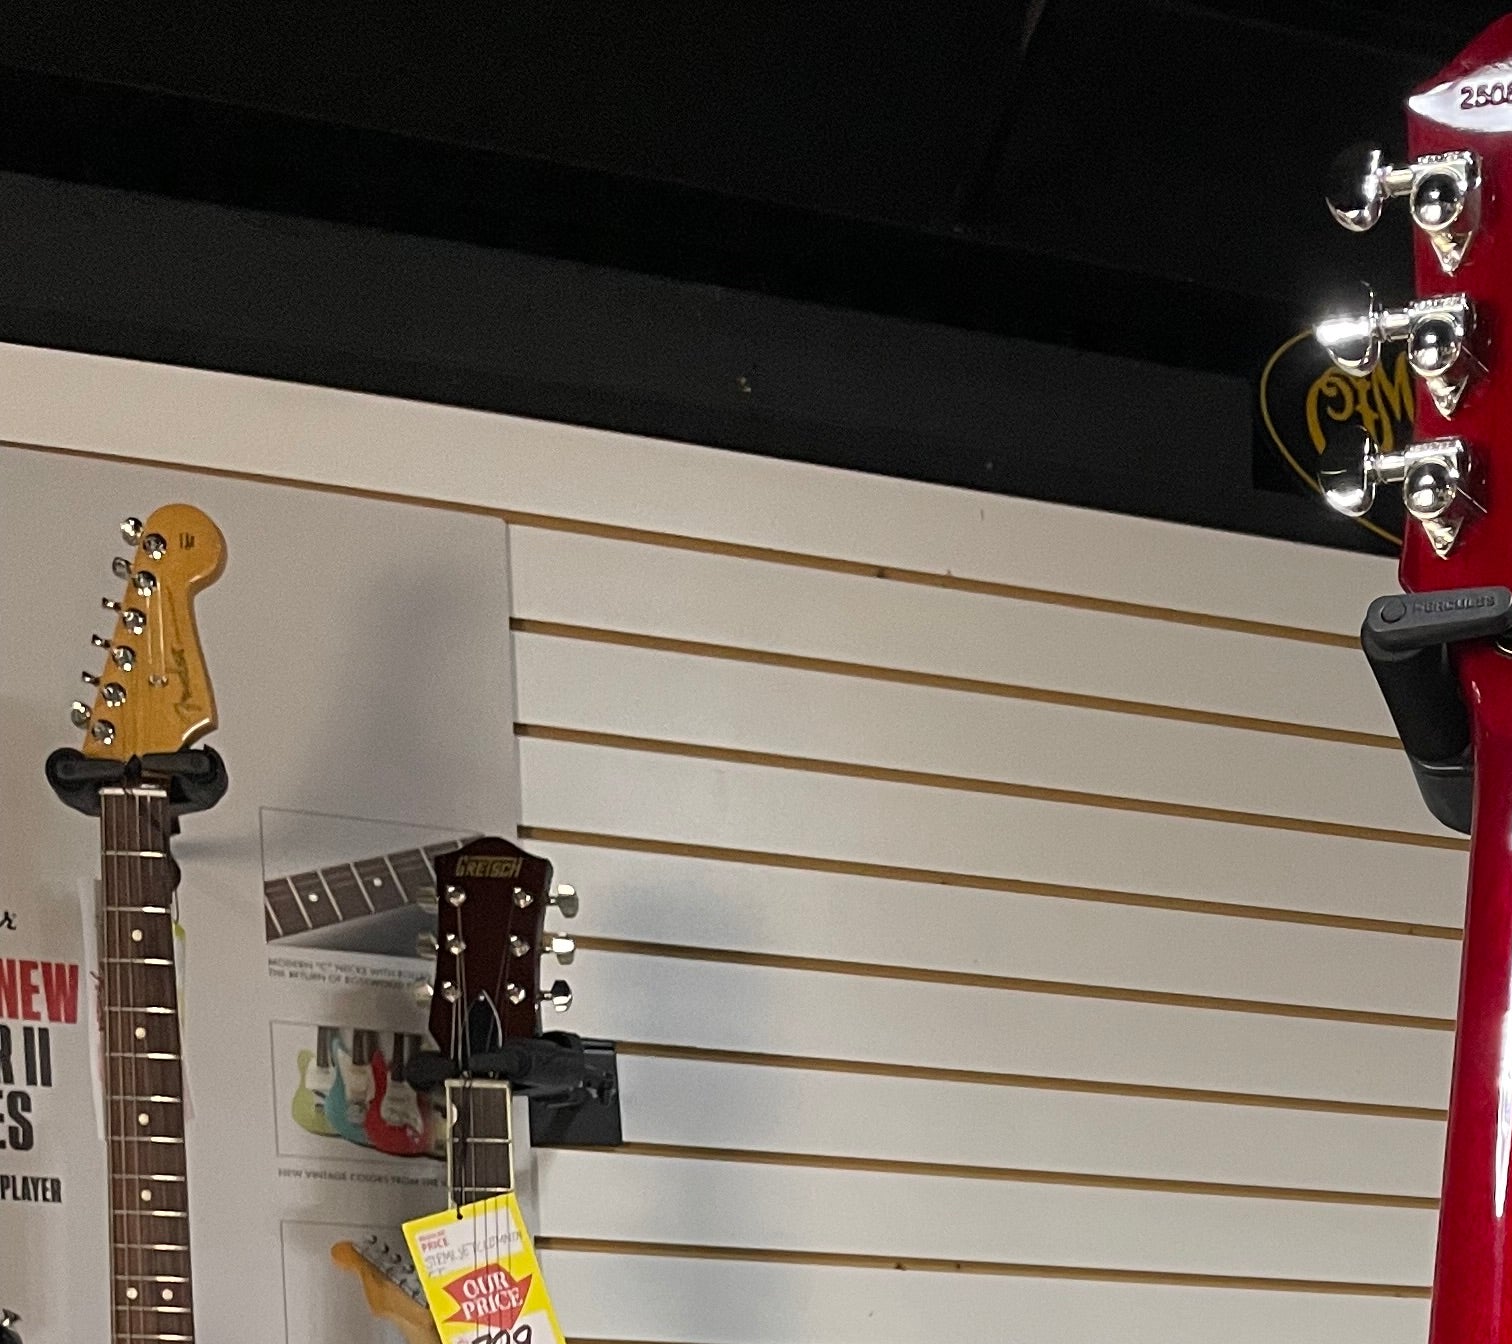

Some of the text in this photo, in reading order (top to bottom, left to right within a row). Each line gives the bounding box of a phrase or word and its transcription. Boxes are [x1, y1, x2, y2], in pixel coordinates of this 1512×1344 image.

[456, 856, 523, 877] GRETSCH
[0, 957, 79, 1024] NEW
[0, 1174, 62, 1203] PLAYER
[463, 1271, 510, 1299] OUR
[460, 1287, 523, 1320] PRICE
